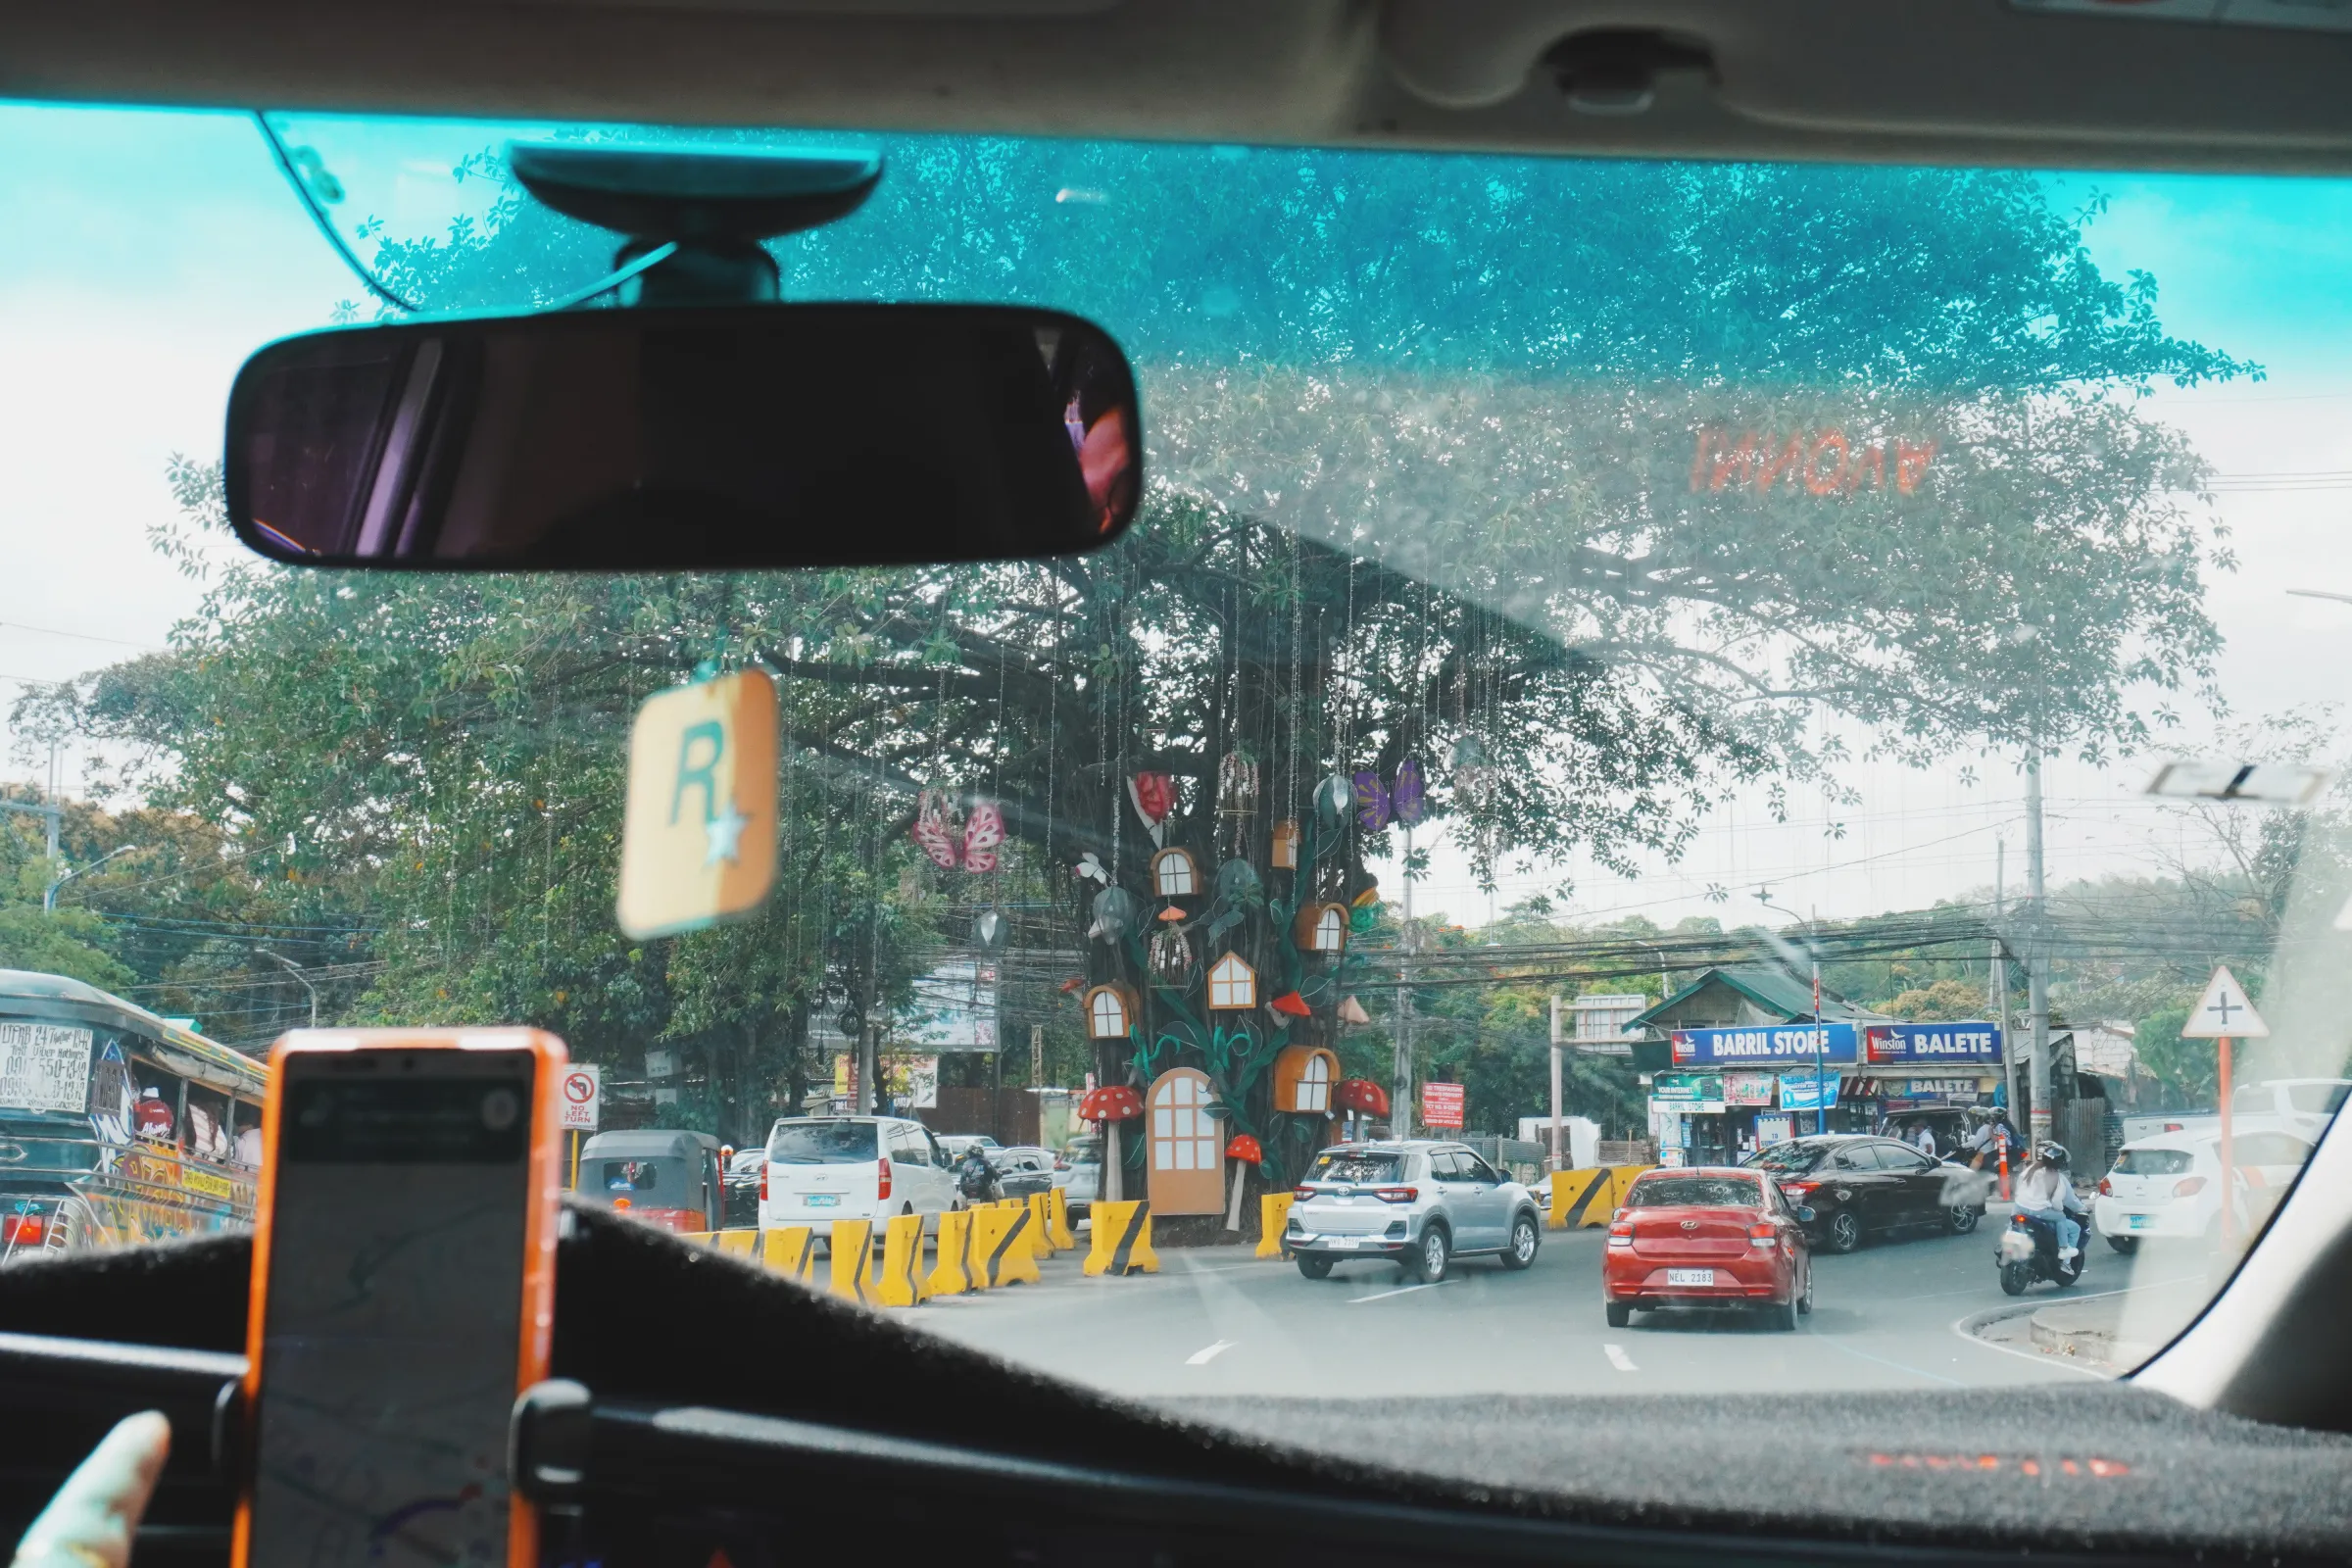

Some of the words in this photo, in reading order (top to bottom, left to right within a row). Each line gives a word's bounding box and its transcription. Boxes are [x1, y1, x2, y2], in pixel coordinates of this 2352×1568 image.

[669, 718, 723, 827] R
[1674, 1040, 1695, 1054] Winston
[1713, 1032, 1771, 1056] BARRIL
[1774, 1030, 1830, 1054] STORE
[1871, 1036, 1906, 1051] Winston
[1914, 1032, 1992, 1054] BALETE
[1911, 1079, 1973, 1093] BALETE
[1669, 1102, 1686, 1111] BARRIL
[1689, 1102, 1705, 1111] STORE
[1669, 1273, 1685, 1283] NEL
[1691, 1273, 1712, 1283] 2183
